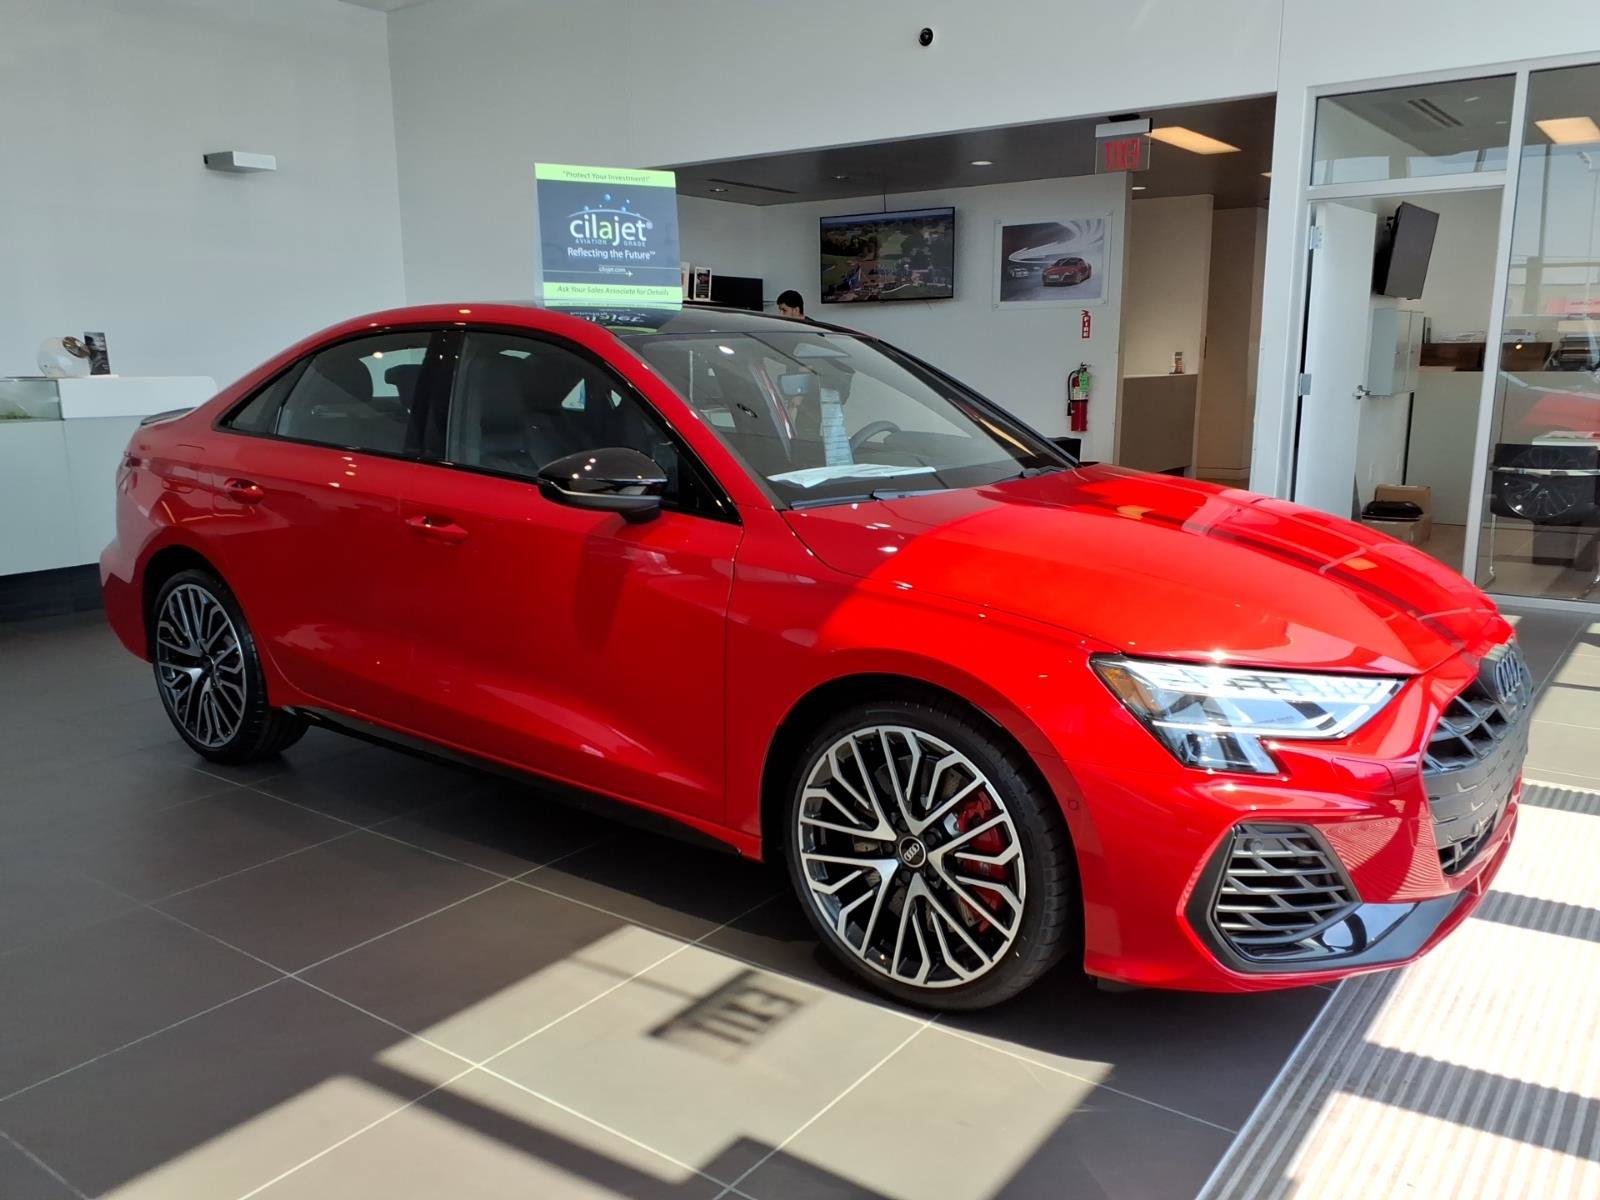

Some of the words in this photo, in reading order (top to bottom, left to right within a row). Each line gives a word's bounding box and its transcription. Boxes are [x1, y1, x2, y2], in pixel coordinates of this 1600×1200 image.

[592, 172, 607, 181] Your
[575, 238, 608, 246] AVIATION
[567, 247, 609, 260] Reflecting
[609, 249, 623, 258] the
[558, 285, 569, 293] Ask
[571, 286, 586, 294] Your
[587, 286, 604, 295] Sales
[605, 287, 635, 296] Associate
[636, 288, 646, 296] for
[1082, 316, 1090, 338] FIRE
